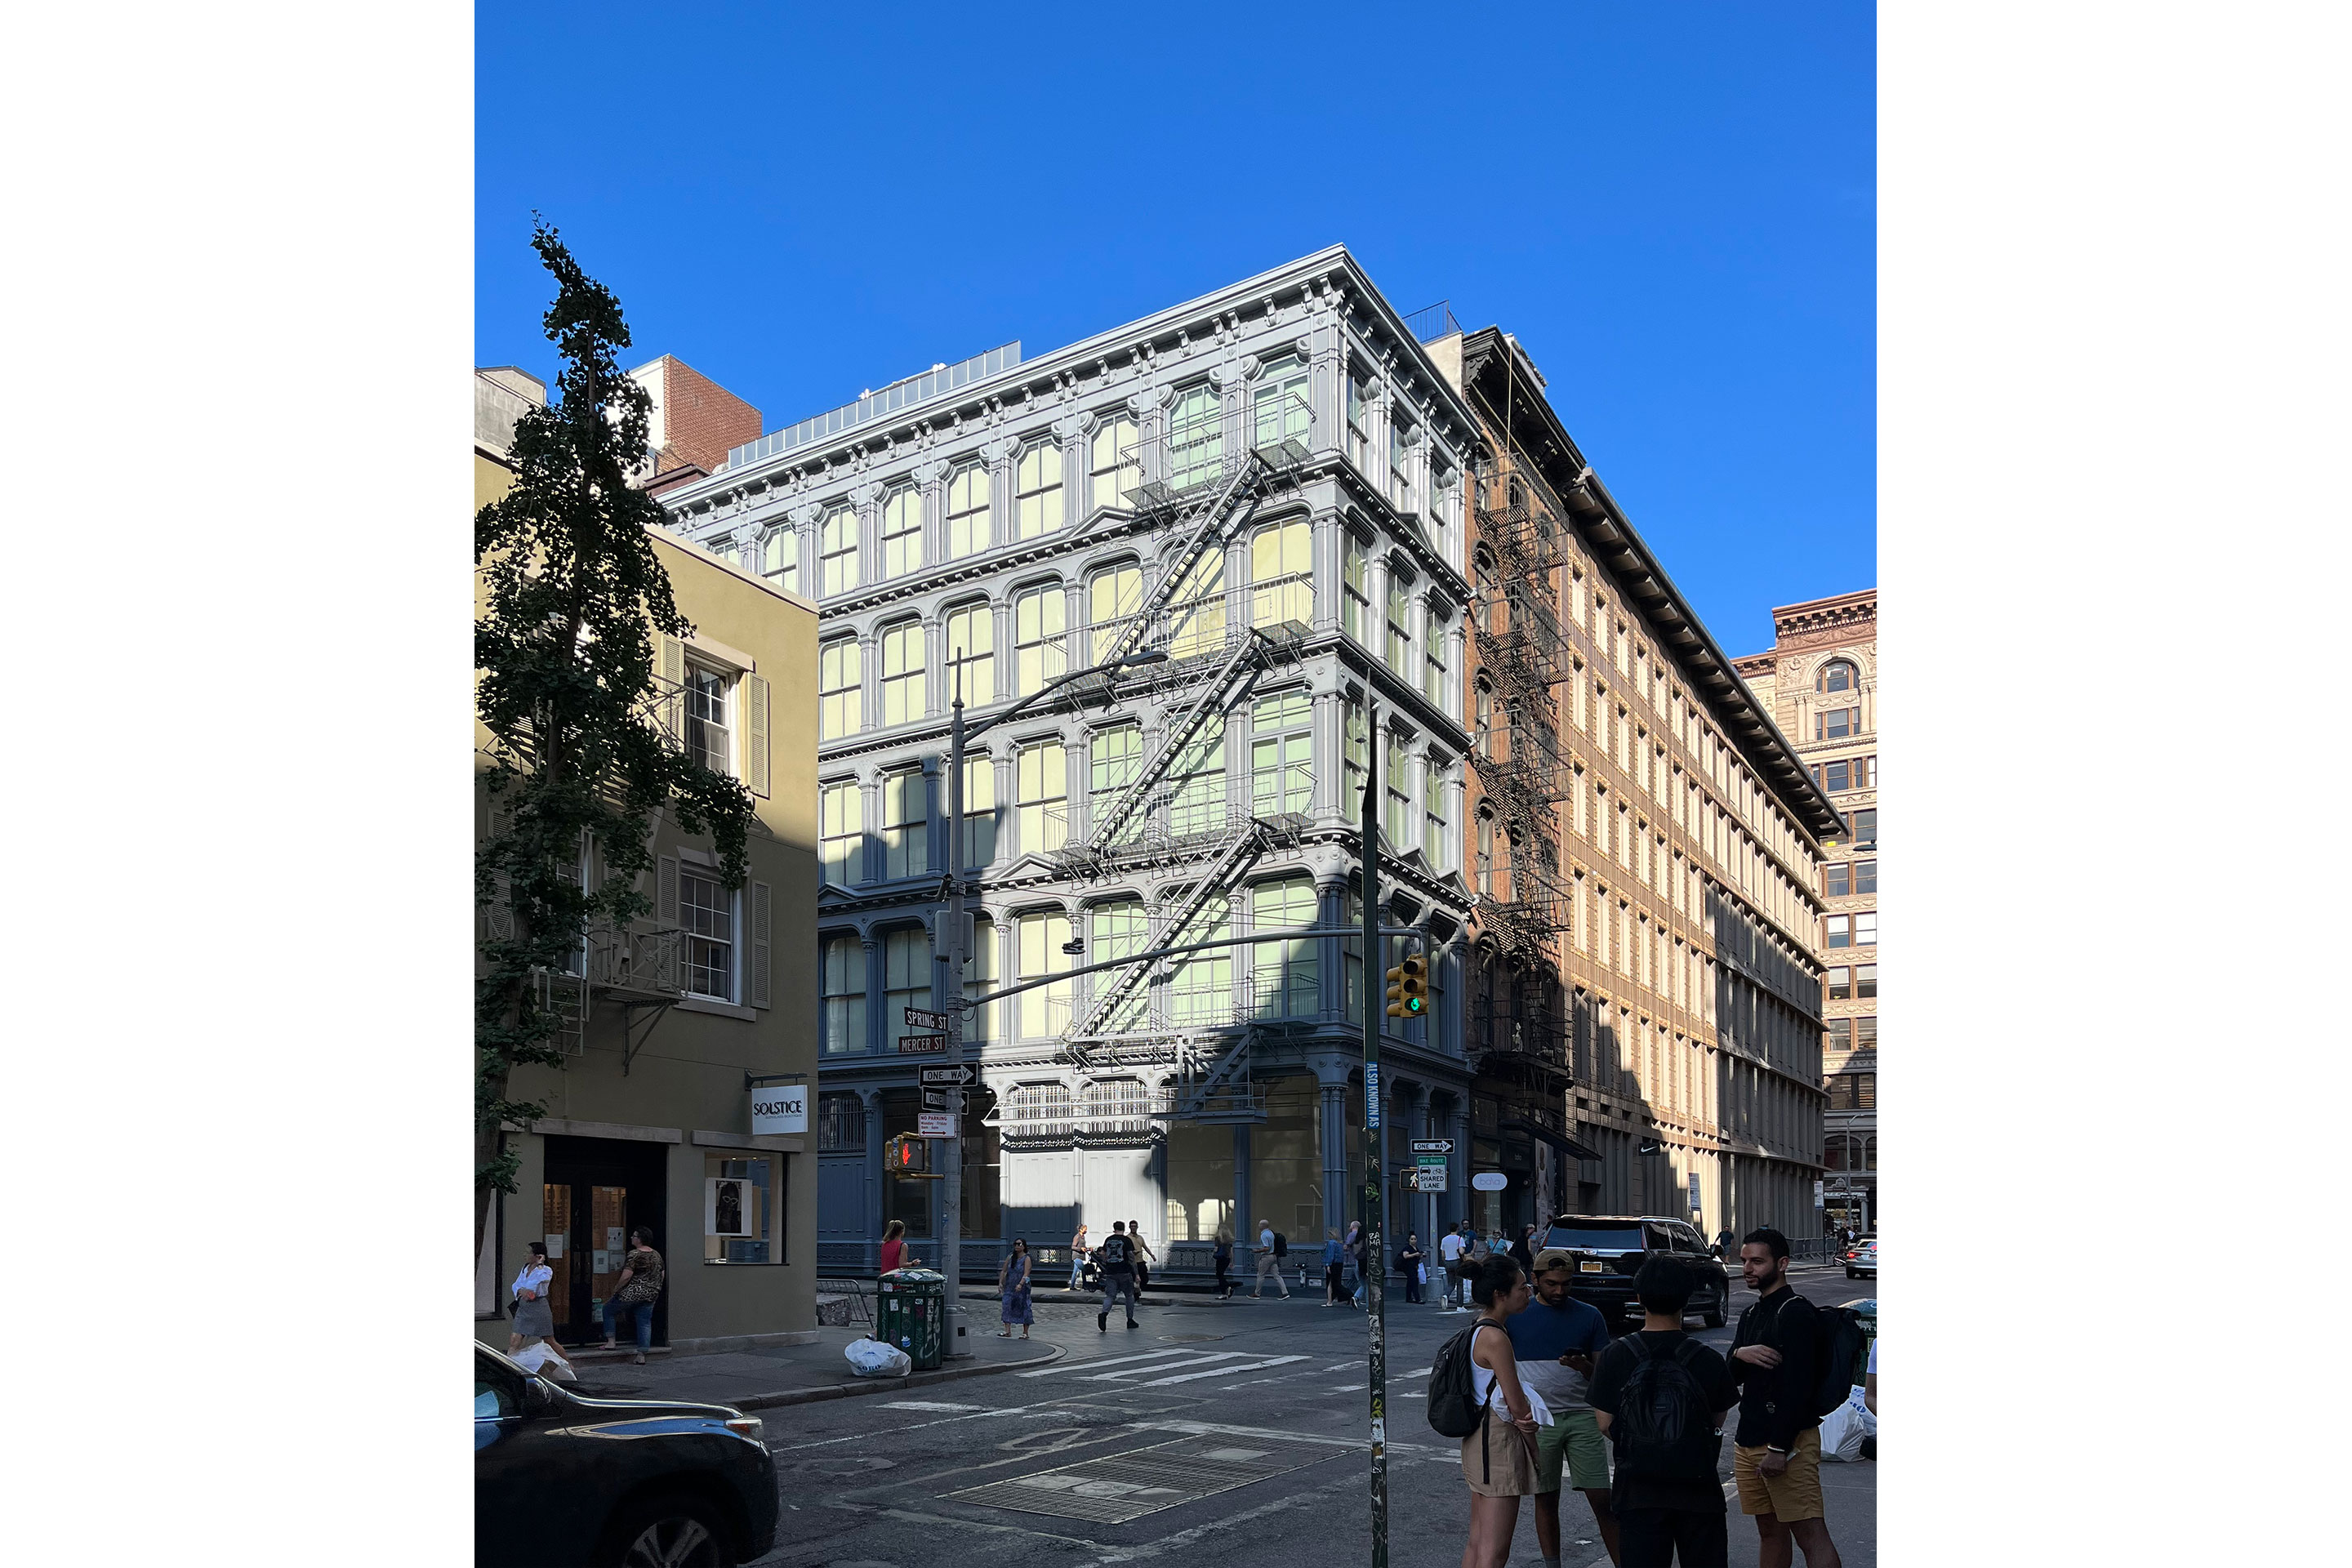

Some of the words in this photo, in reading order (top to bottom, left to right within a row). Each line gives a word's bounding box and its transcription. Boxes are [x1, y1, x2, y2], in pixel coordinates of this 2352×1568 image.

[907, 1011, 935, 1027] SPRING
[938, 1016, 947, 1029] ST
[902, 1038, 931, 1052] MERCER
[934, 1037, 943, 1050] ST
[927, 1071, 944, 1080] ONE
[951, 1070, 969, 1080] WAY
[1367, 1063, 1379, 1085] ALSO
[929, 1094, 943, 1104] ONE
[1368, 1085, 1379, 1116] KNOWN
[753, 1100, 802, 1116] SOLSTICE
[1369, 1116, 1380, 1127] AS
